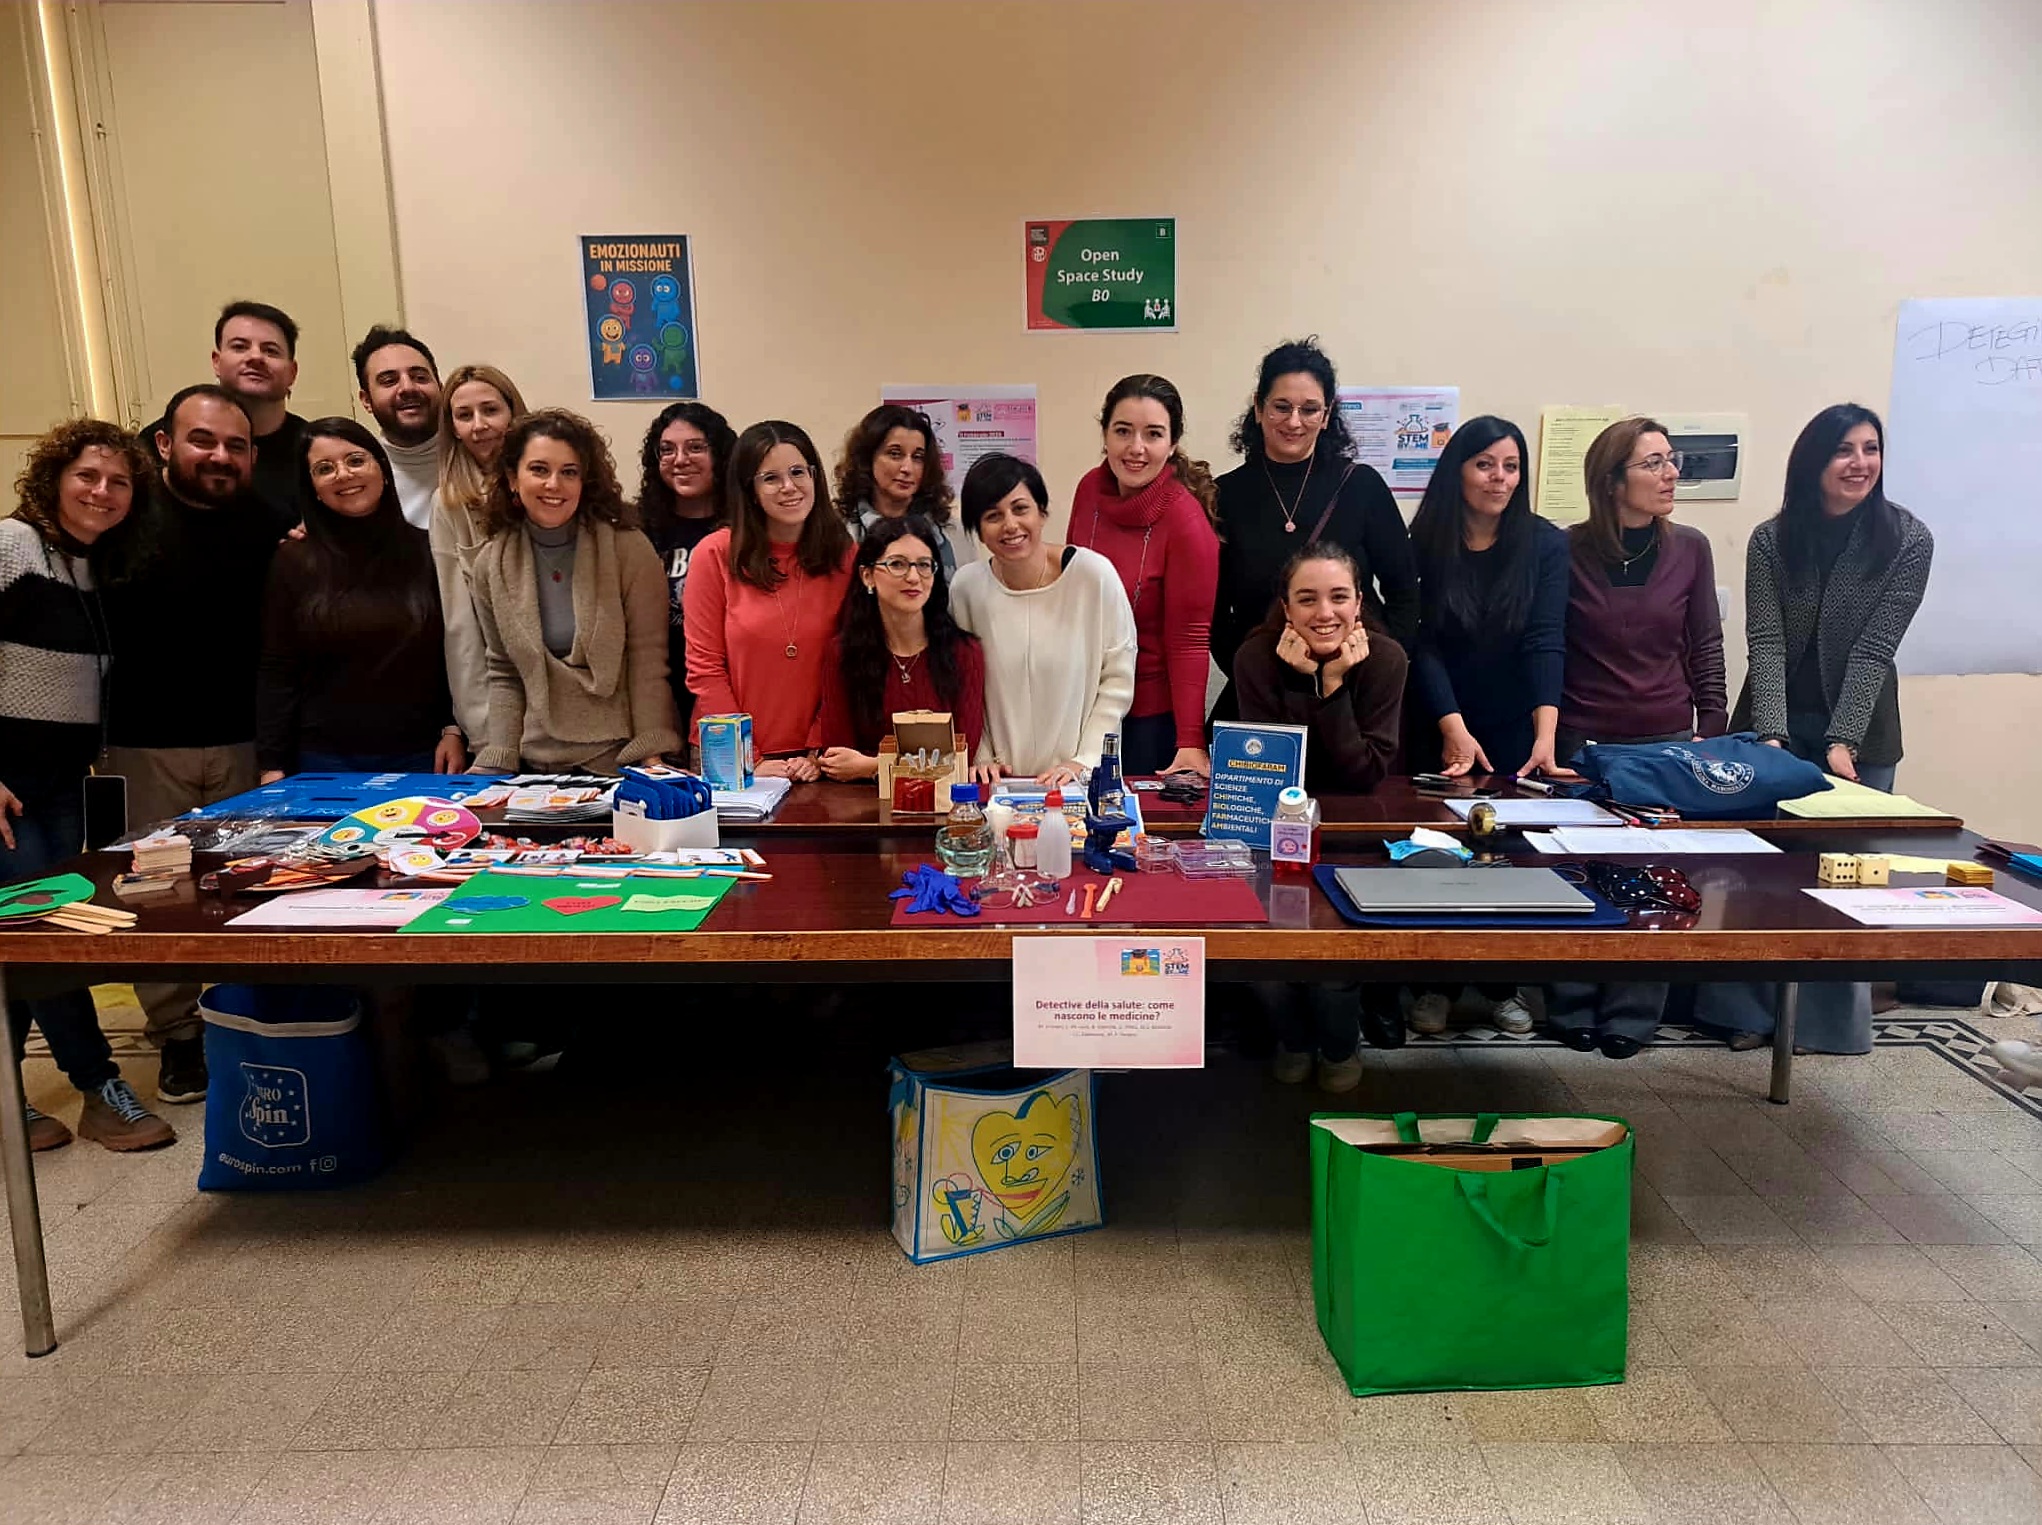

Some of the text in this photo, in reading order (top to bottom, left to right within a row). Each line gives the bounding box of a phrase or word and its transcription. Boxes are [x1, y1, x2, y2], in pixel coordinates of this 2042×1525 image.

[589, 243, 681, 259] EMOZIONAUTI
[1080, 249, 1120, 264] Open
[600, 260, 673, 272] IN MISSIONE
[1057, 268, 1144, 285] Space Study
[1398, 434, 1429, 443] STEM
[1215, 772, 1274, 785] DIPARTIMENTO
[1214, 783, 1248, 792] SCIENZE
[1213, 802, 1264, 815] BIOLOGICHE,
[1211, 812, 1272, 825] FARMACEUTICH
[1211, 822, 1258, 834] AMBIENTALI
[1035, 1000, 1175, 1010] Detective della salute: come
[1054, 1011, 1161, 1021] nascono le medicine?
[249, 1095, 290, 1128] Spin
[219, 1153, 302, 1175] eurospin.com
